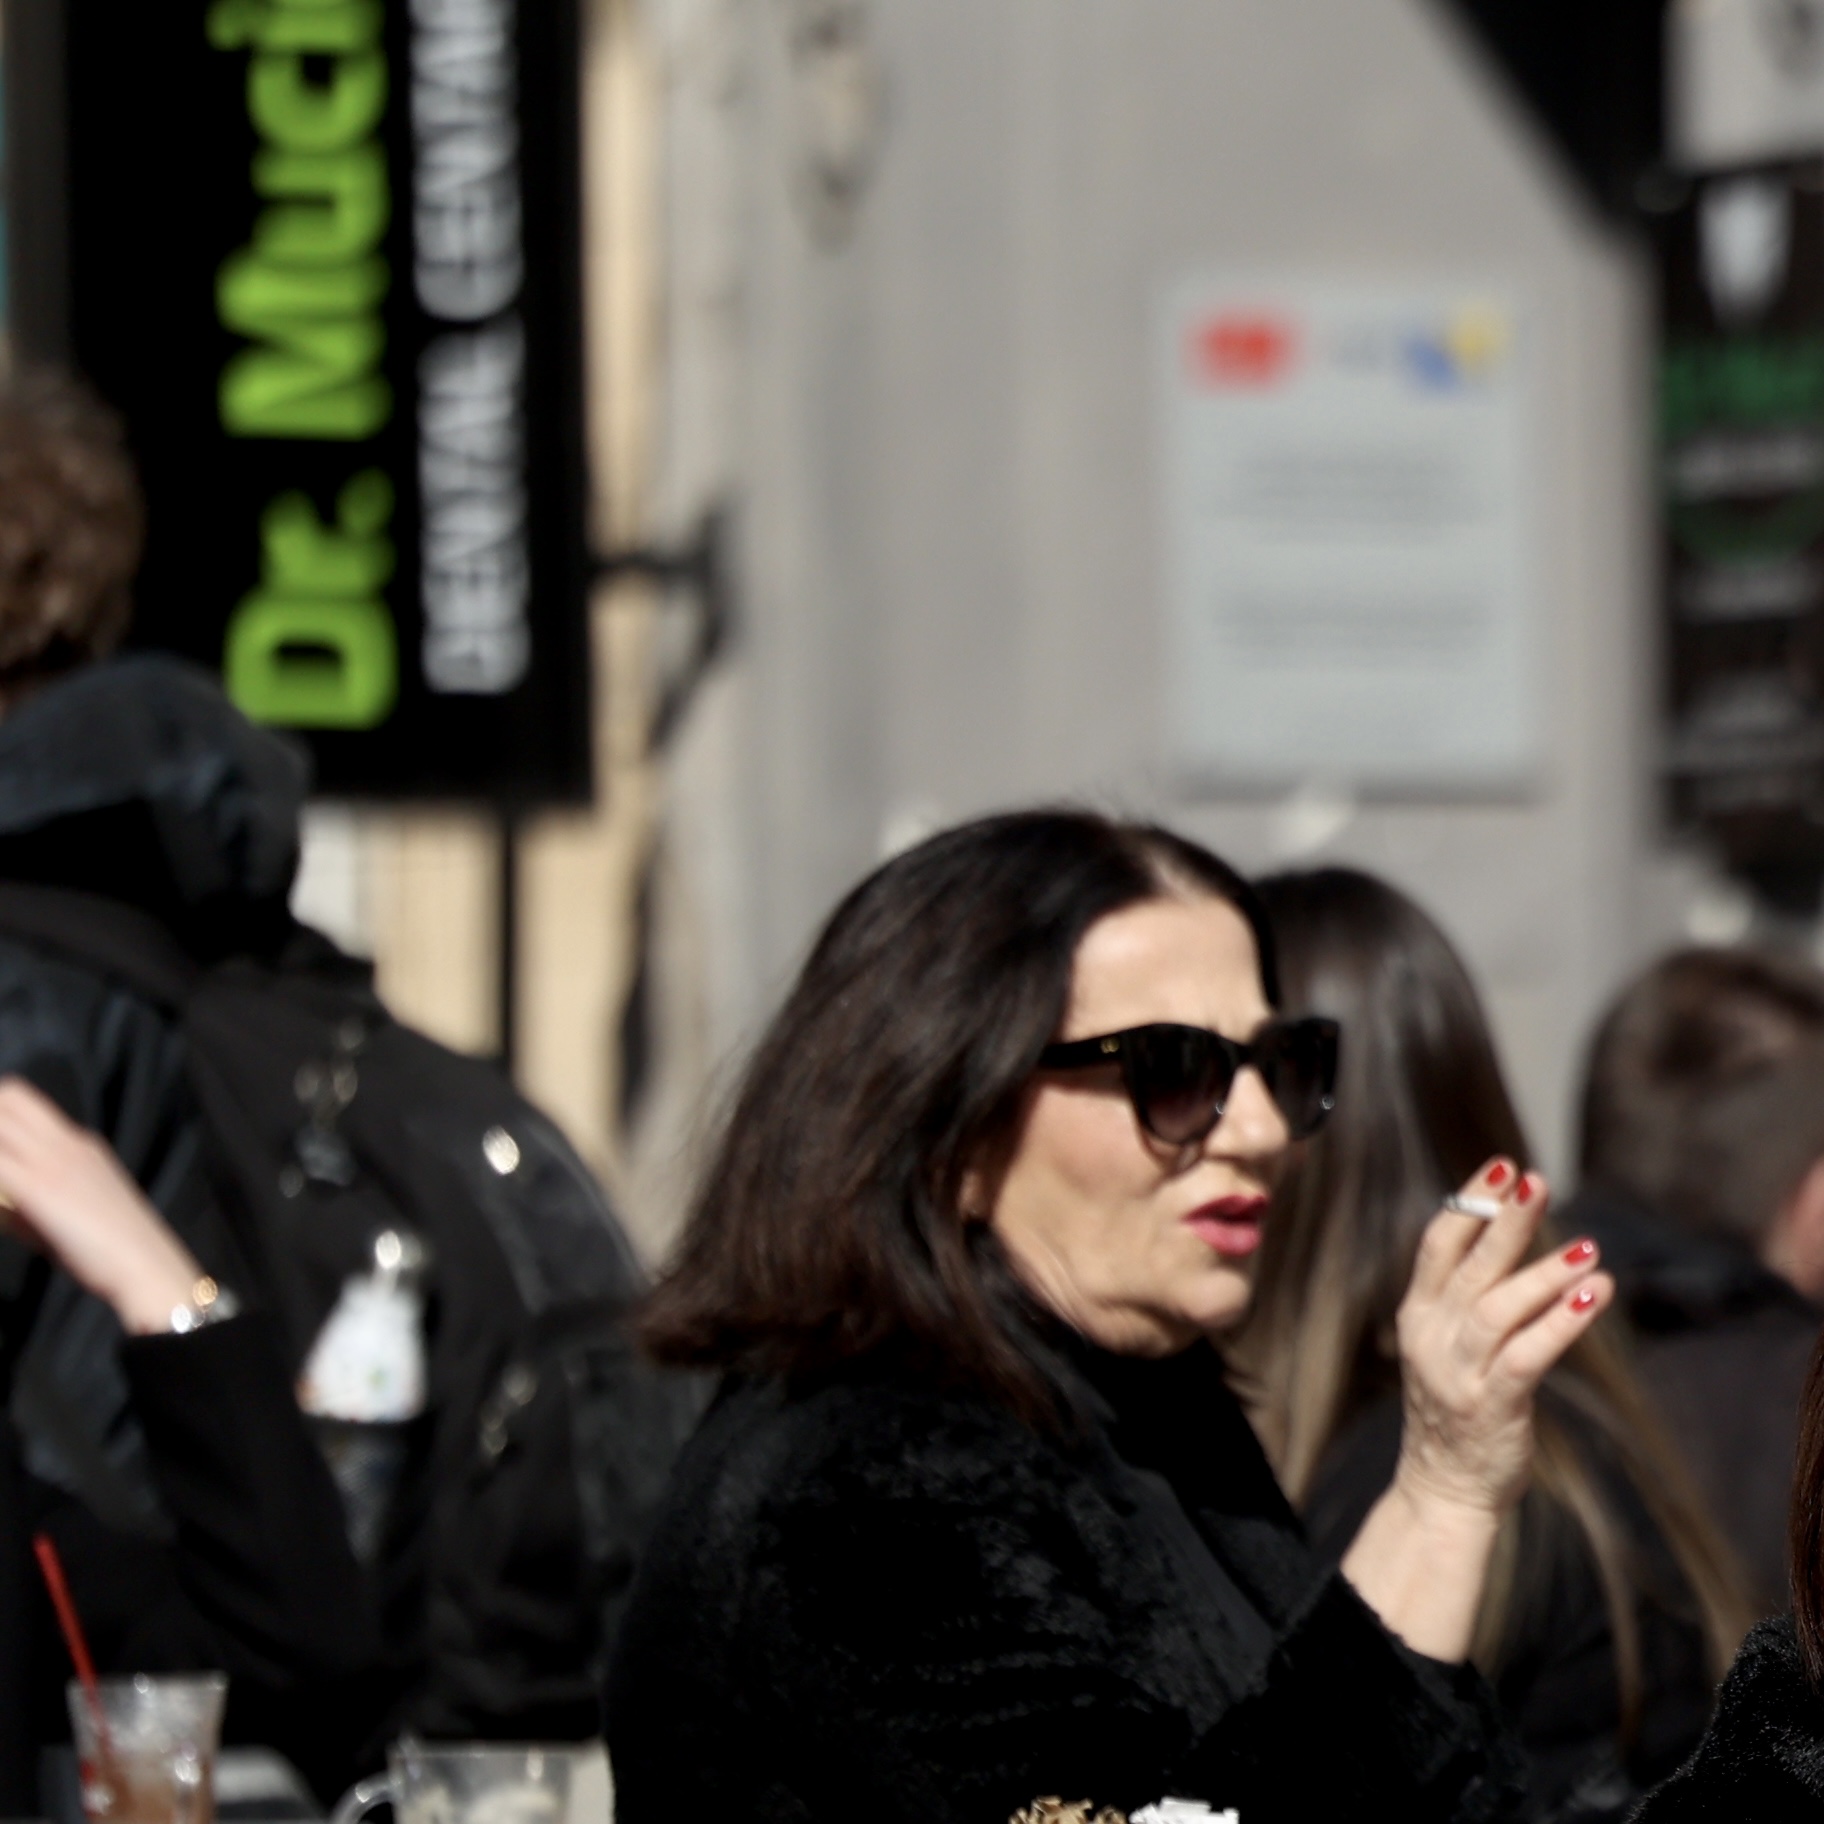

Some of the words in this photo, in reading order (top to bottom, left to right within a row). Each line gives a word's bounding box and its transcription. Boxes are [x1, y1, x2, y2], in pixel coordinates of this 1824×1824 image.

[206, 0, 391, 439] Muci
[224, 468, 397, 729] Dr.
[417, 316, 529, 693] DENTAL
